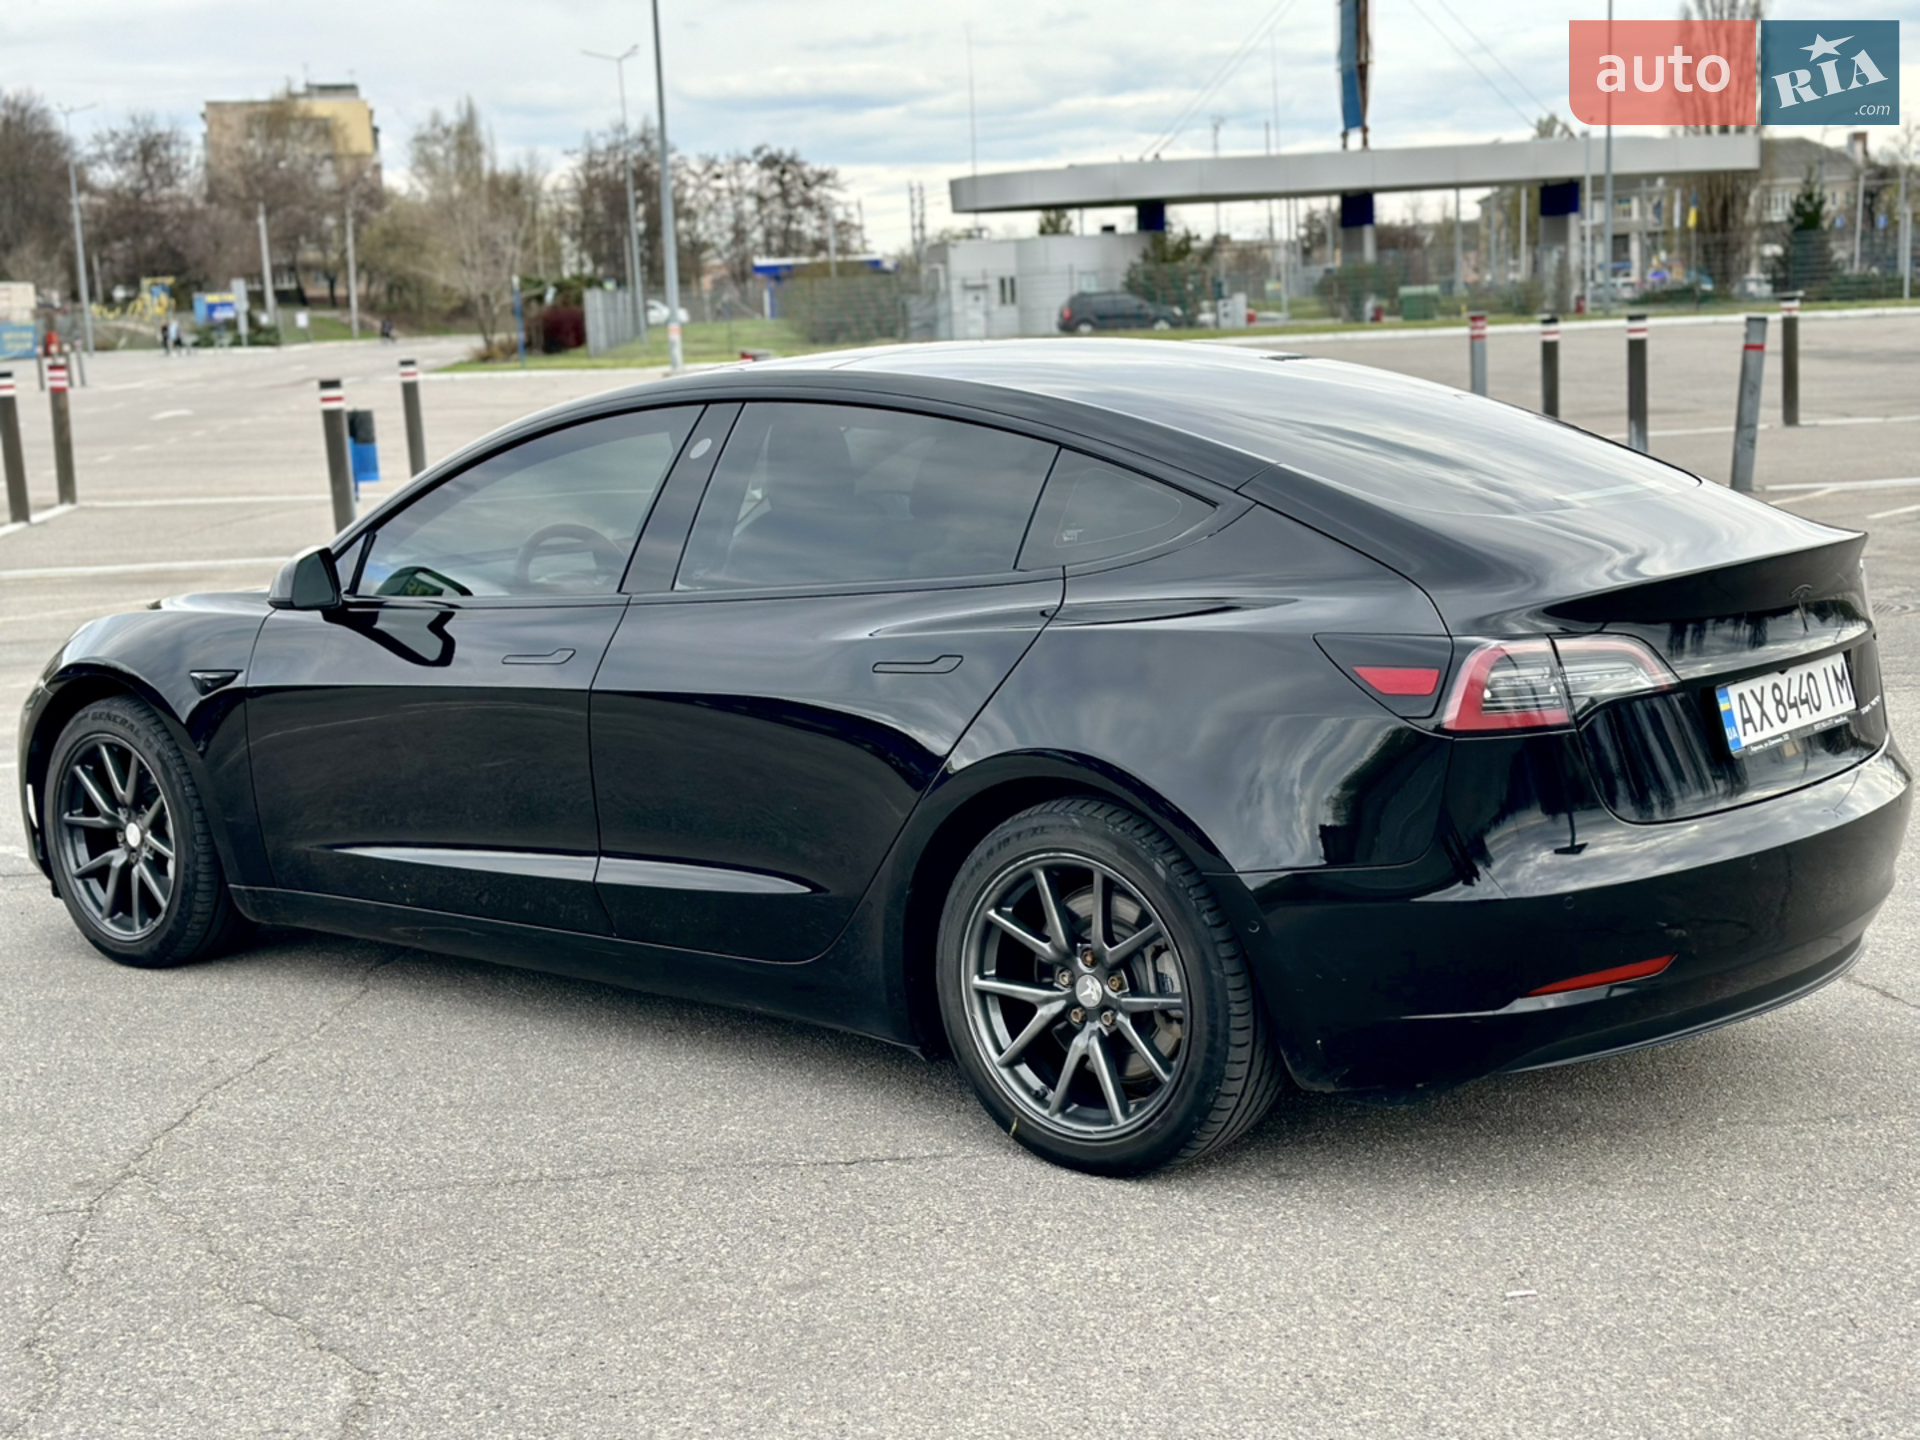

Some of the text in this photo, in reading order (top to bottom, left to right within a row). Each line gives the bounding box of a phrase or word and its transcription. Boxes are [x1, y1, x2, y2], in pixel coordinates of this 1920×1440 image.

[90, 710, 142, 739] GENERAL
[1737, 661, 1853, 737] AX 8440 IM
